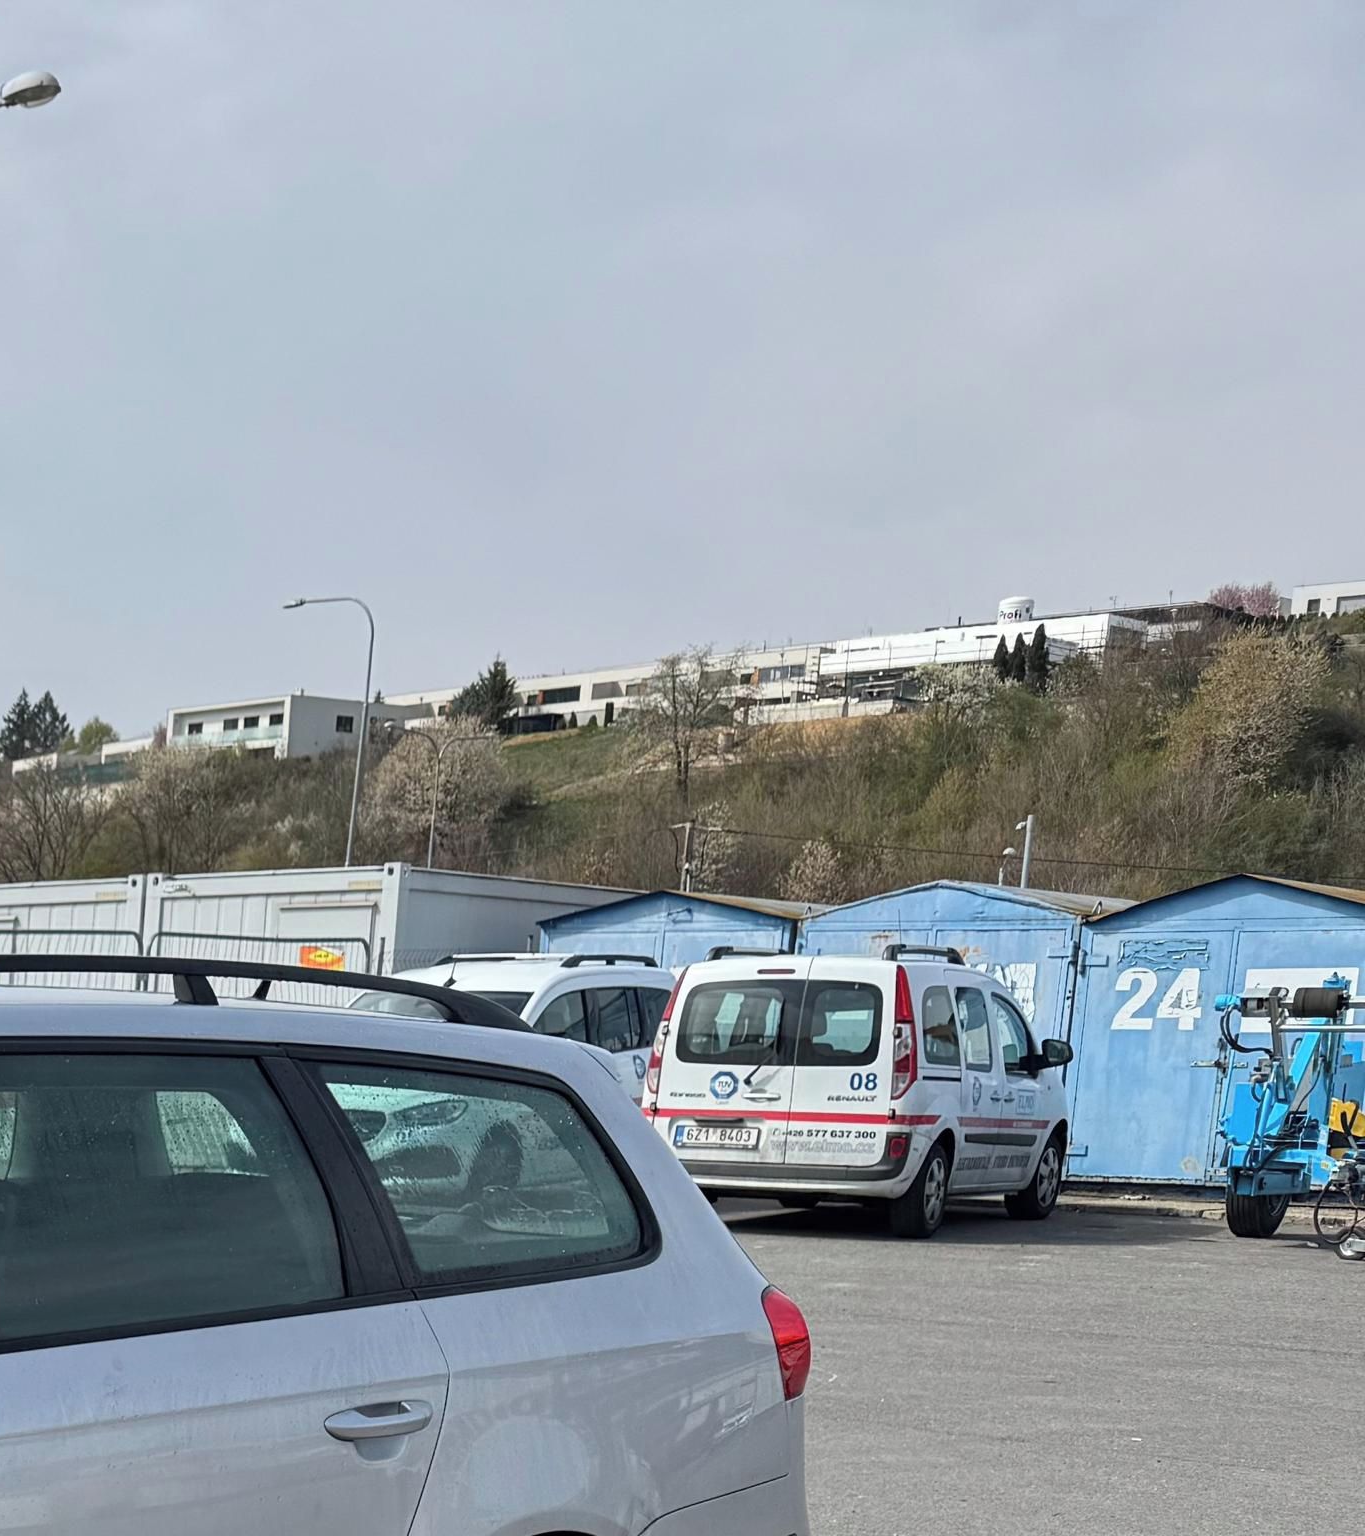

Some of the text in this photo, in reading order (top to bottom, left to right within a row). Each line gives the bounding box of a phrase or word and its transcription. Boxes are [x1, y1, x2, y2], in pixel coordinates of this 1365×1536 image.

[1110, 967, 1202, 1031] 24
[849, 1072, 878, 1092] 08
[686, 1128, 751, 1142] 6Z1 8403
[807, 1130, 828, 1138] 577
[830, 1130, 852, 1138] 637
[854, 1131, 877, 1139] 300
